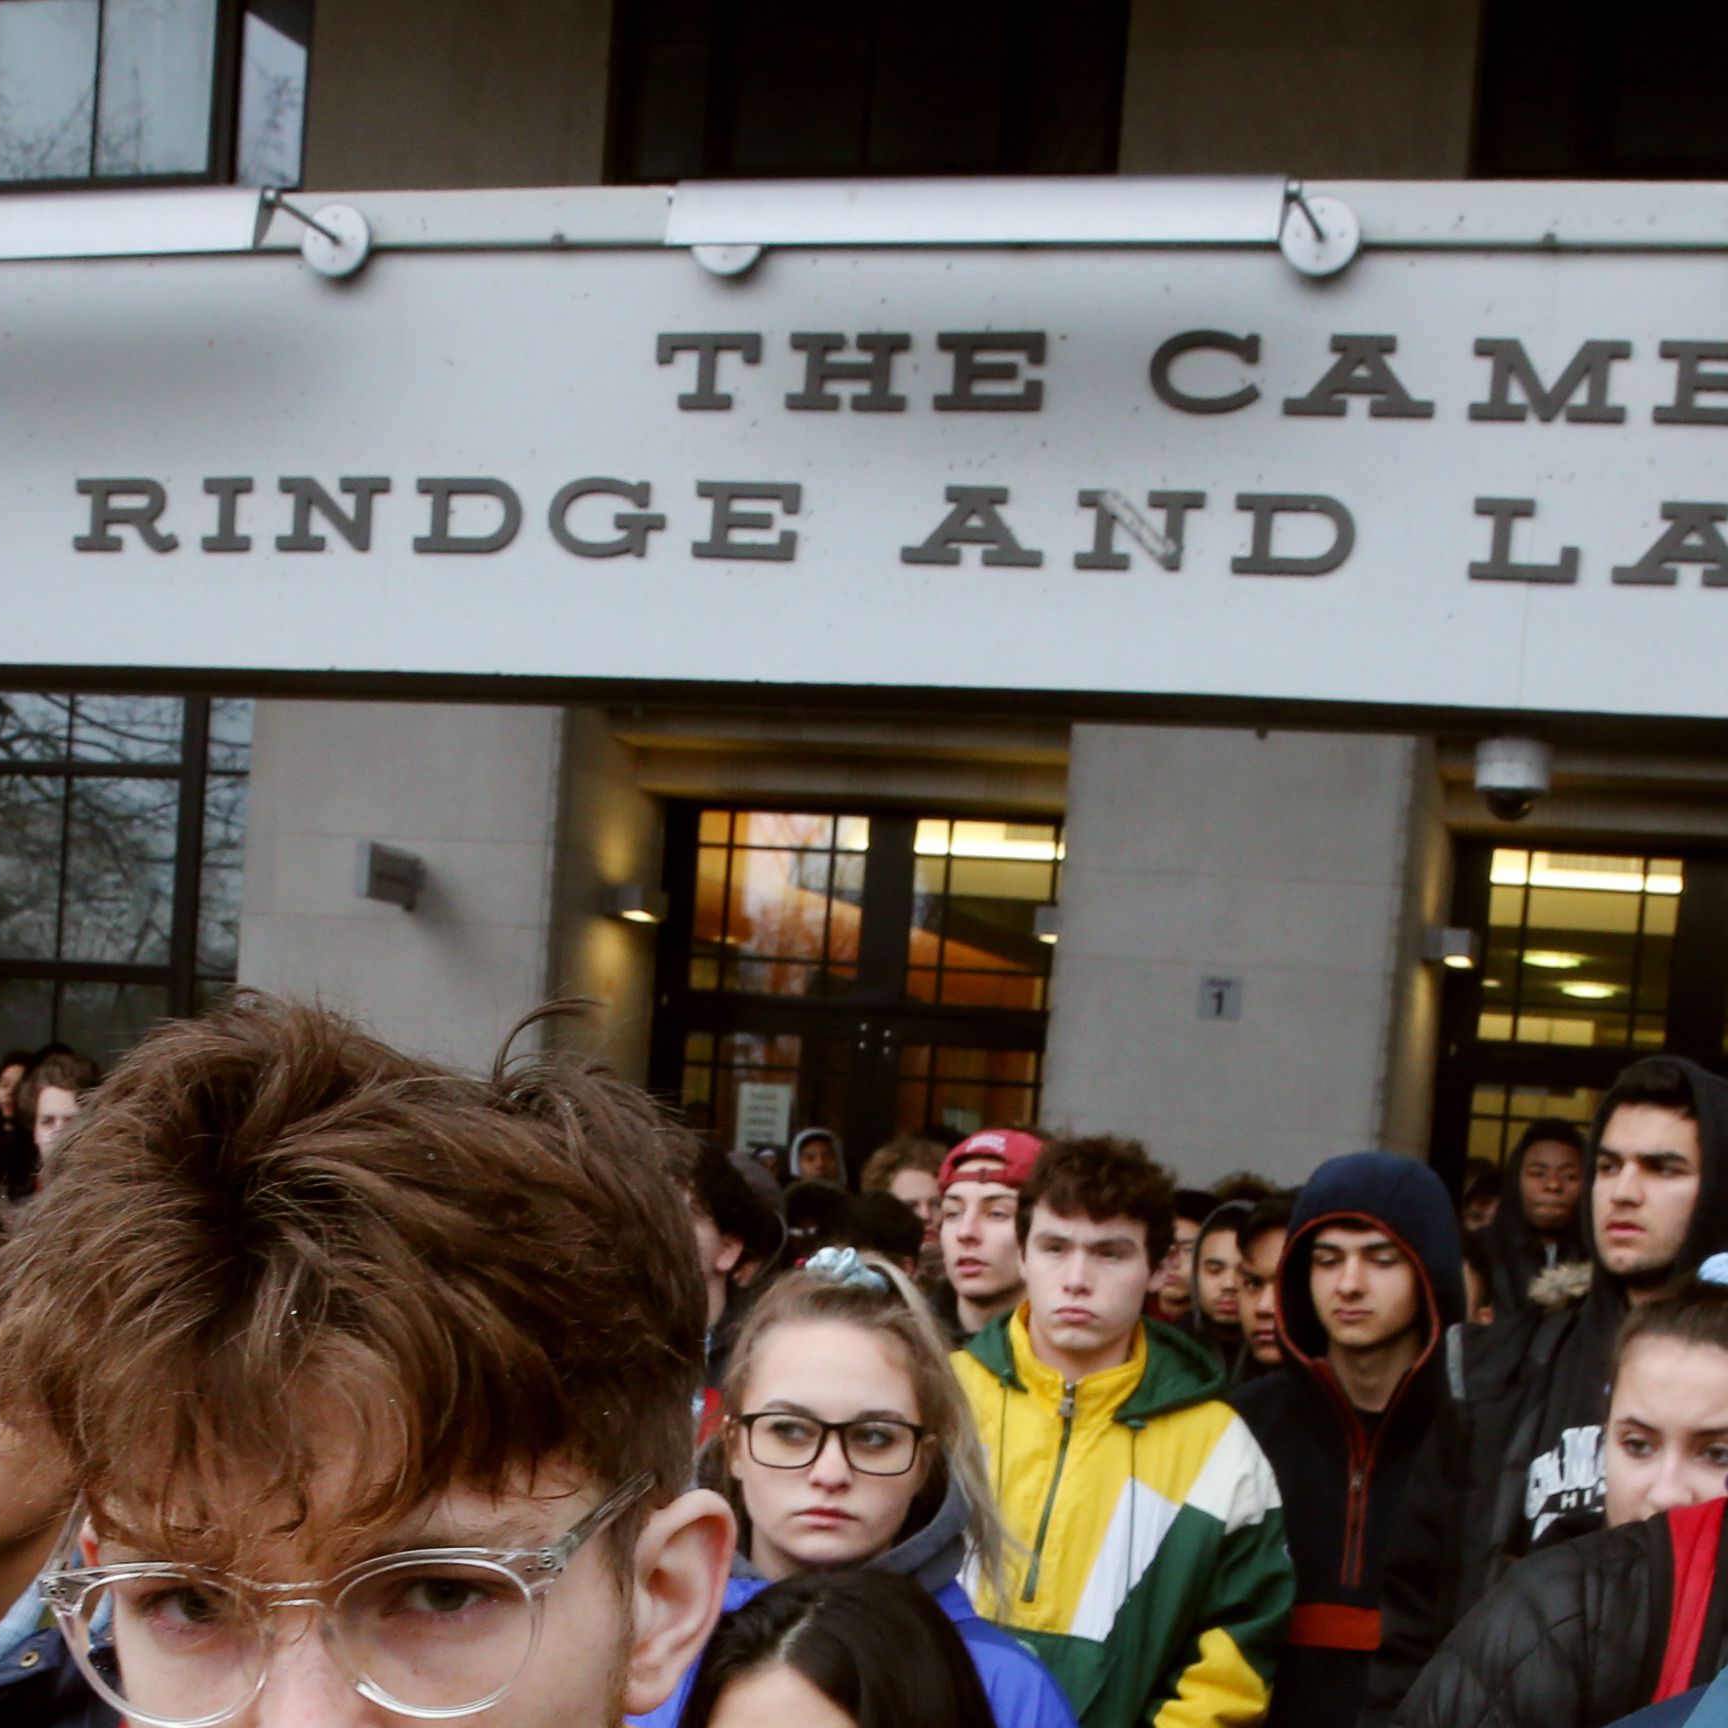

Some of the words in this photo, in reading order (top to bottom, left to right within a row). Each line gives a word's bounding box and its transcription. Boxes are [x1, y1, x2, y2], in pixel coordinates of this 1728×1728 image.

[657, 330, 1044, 416] THE
[74, 477, 801, 563] RINDGE
[901, 486, 1355, 577] AND
